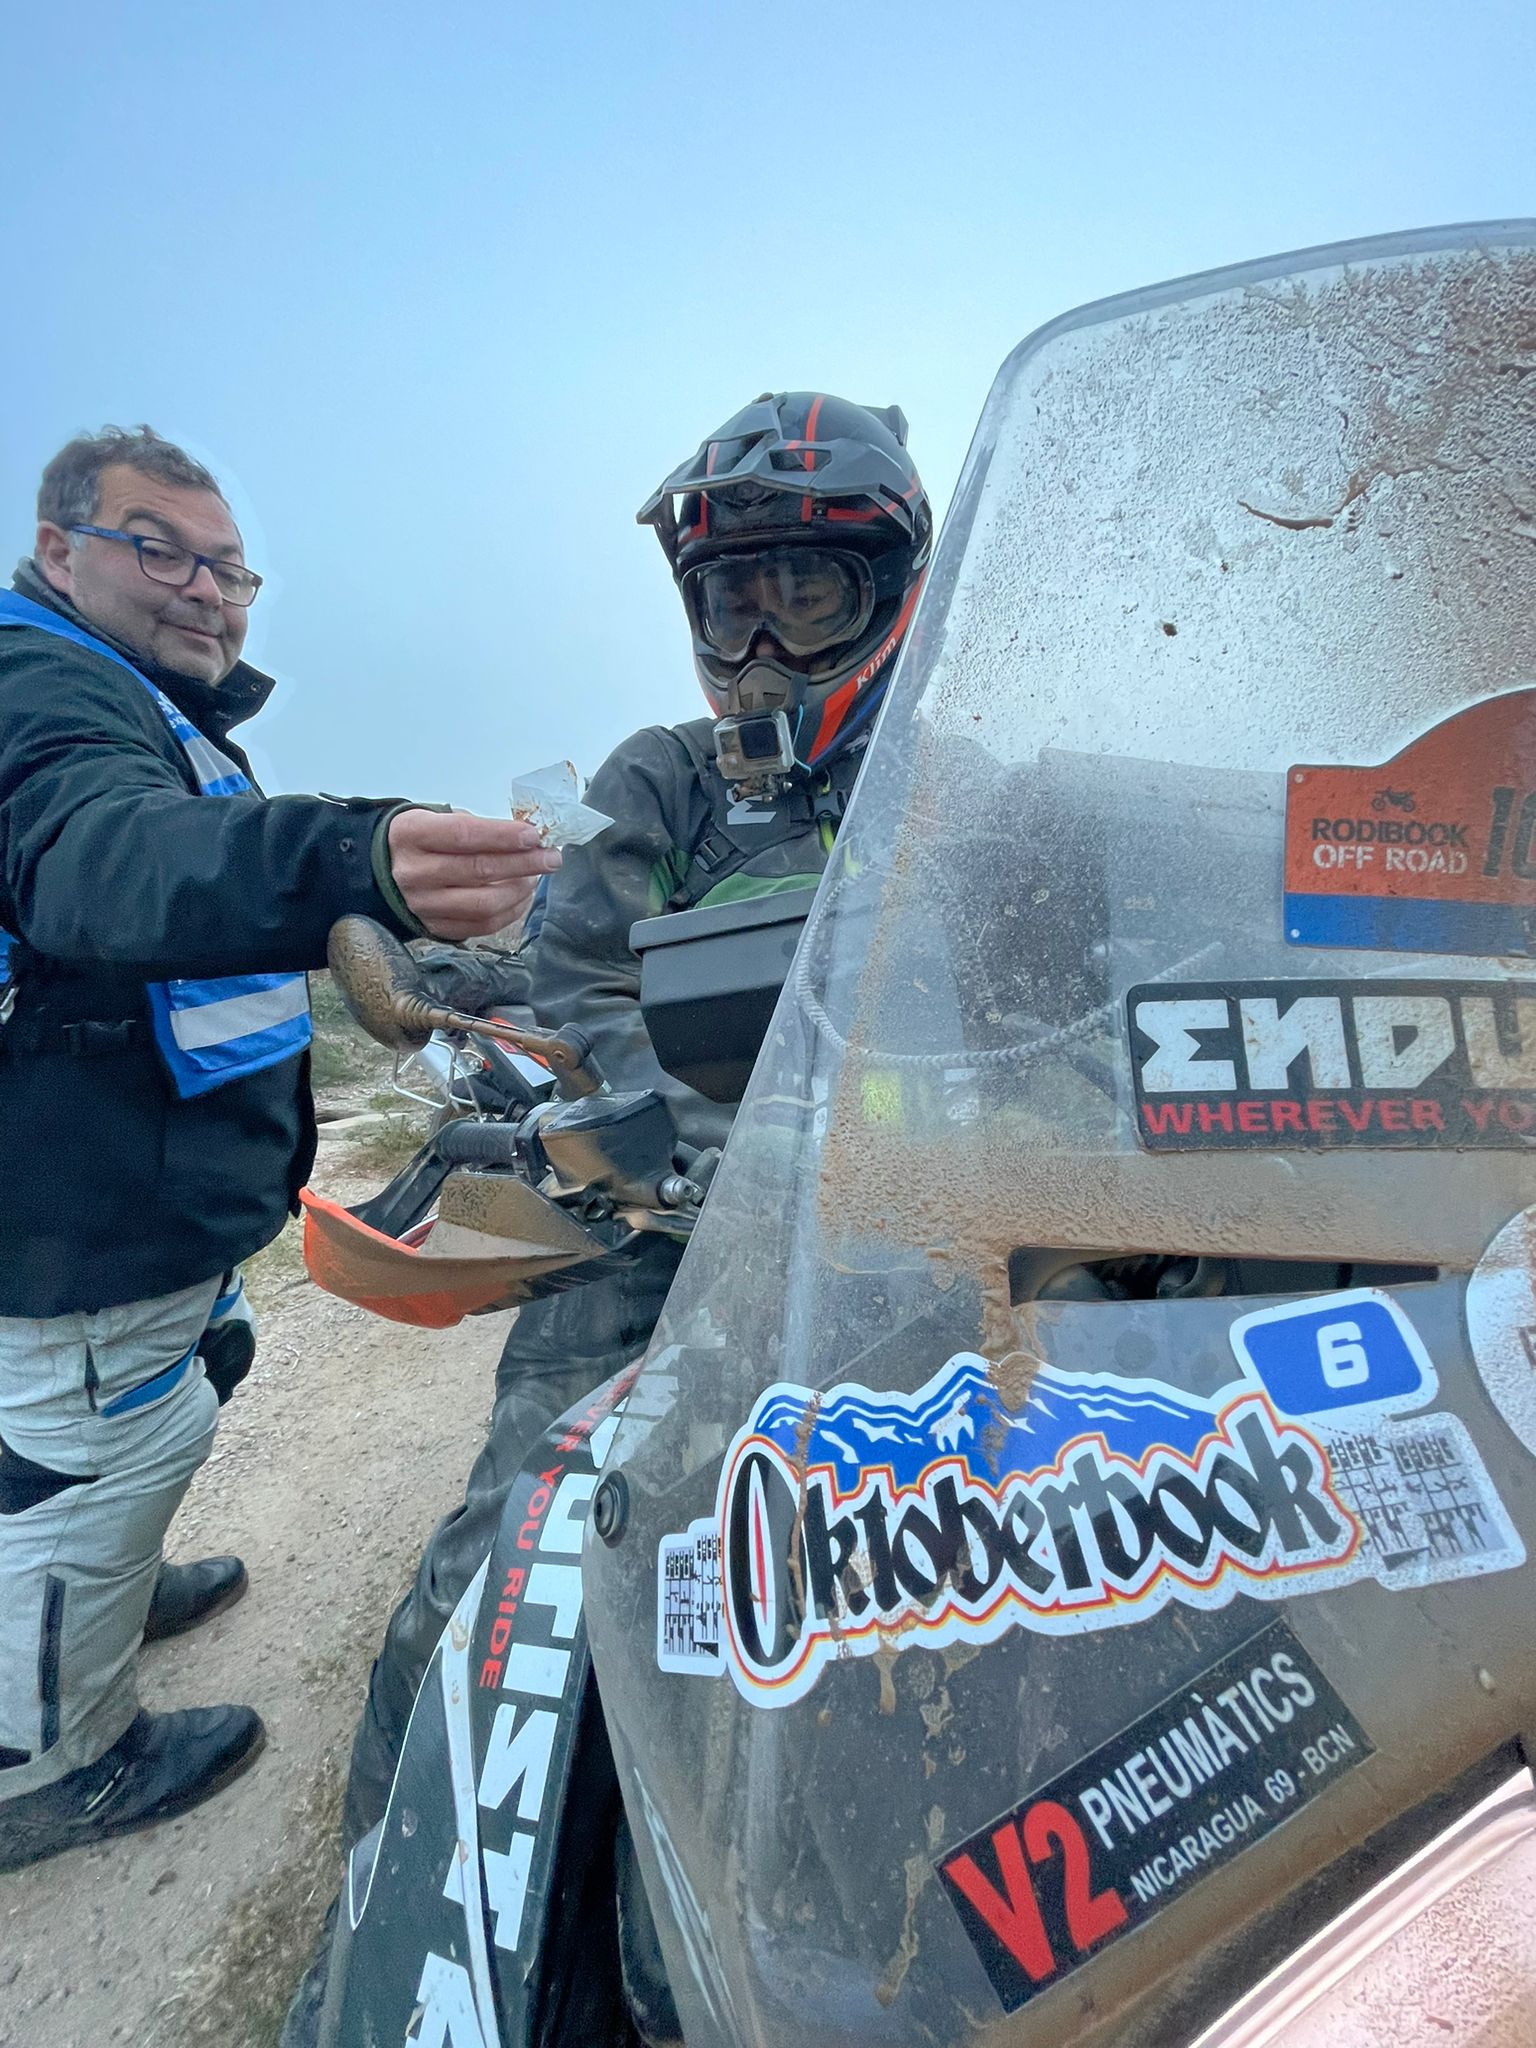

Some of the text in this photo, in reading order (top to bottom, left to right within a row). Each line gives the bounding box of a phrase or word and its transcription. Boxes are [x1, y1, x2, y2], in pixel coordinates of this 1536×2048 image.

[856, 637, 897, 690] Klim
[1311, 817, 1471, 848] RODIBOOK
[1313, 844, 1468, 875] OFF ROAD
[1141, 1099, 1445, 1135] WHEREVER
[1316, 1320, 1370, 1389] 6
[516, 1463, 565, 1551] YOU
[479, 1568, 522, 1690] RIDE
[1129, 1793, 1266, 1903] NICARAGUA
[1263, 1768, 1296, 1804] 69
[943, 1800, 1129, 1982] V2
